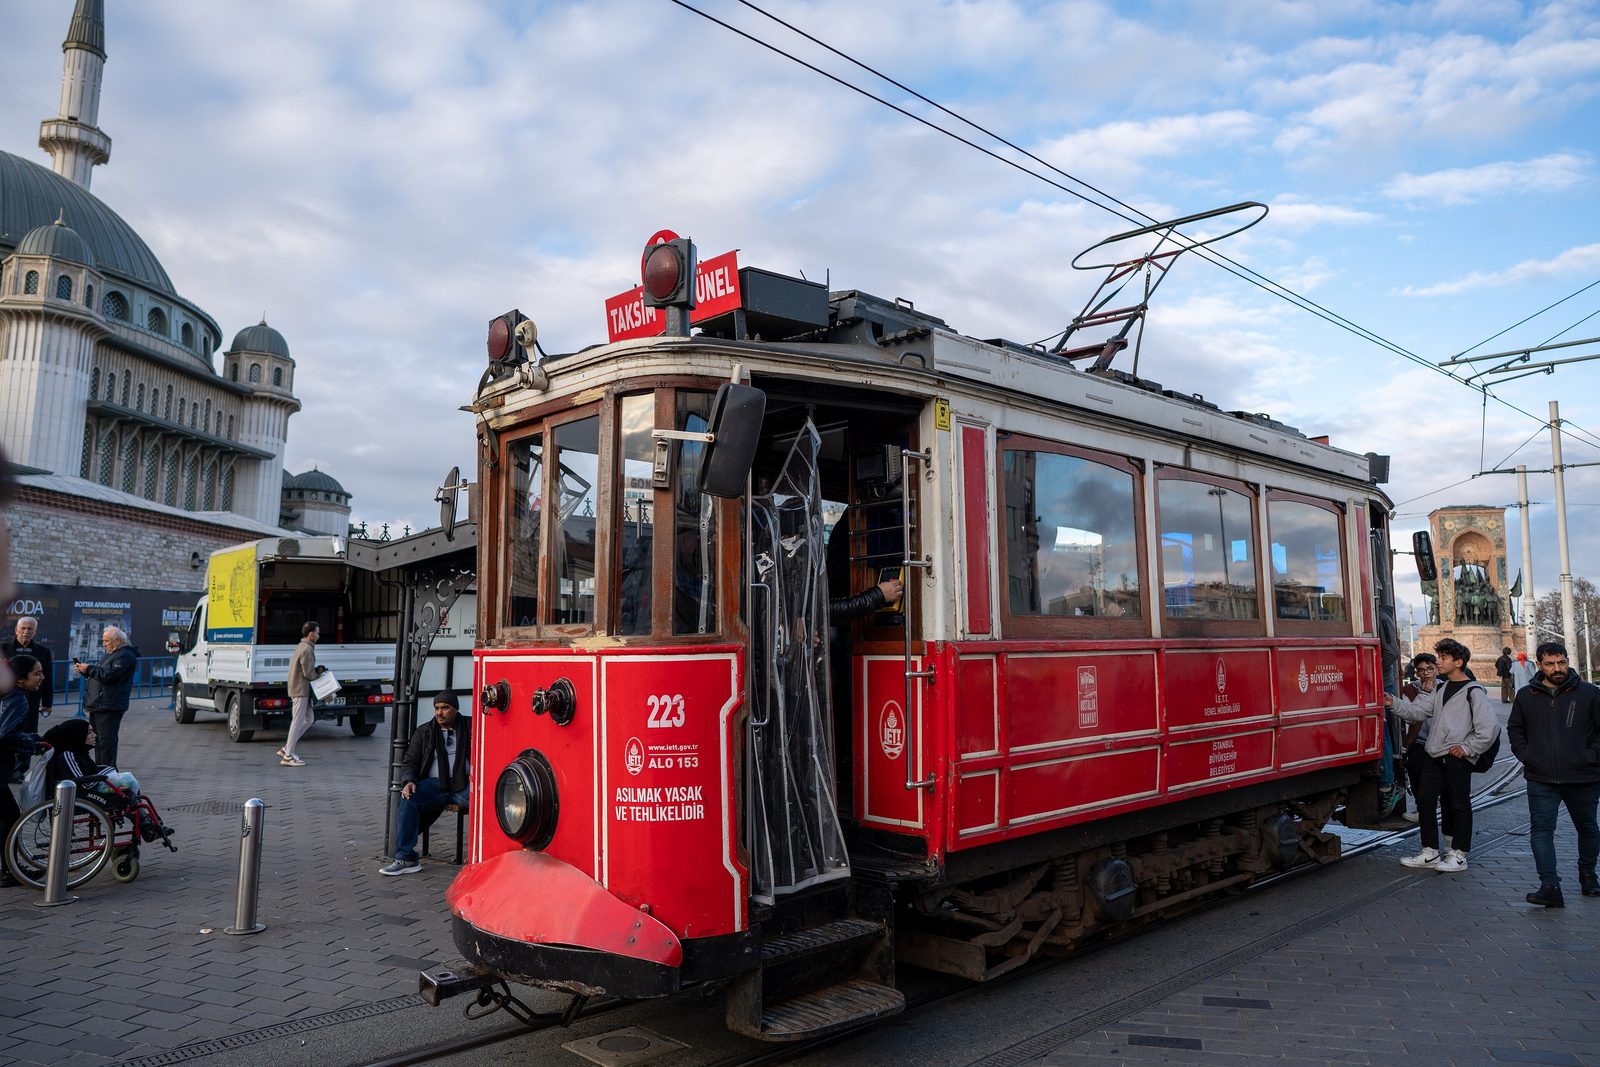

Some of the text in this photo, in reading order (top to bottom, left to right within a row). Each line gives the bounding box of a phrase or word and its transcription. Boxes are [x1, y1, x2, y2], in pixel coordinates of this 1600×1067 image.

[610, 265, 735, 335] TAKSİM ÜNEL
[1310, 669, 1344, 685] BÜYÜKŞEHİR
[647, 694, 685, 728] 223
[1212, 740, 1234, 751] İSTANBUL
[648, 757, 699, 769] ALO 153
[1208, 750, 1237, 764] BÜYÜKŞEHİR
[1209, 762, 1236, 777] BELEDİYESİ
[616, 785, 703, 803] ASILMAK YASAK
[615, 802, 705, 821] VE TEHLİKELİDİR
